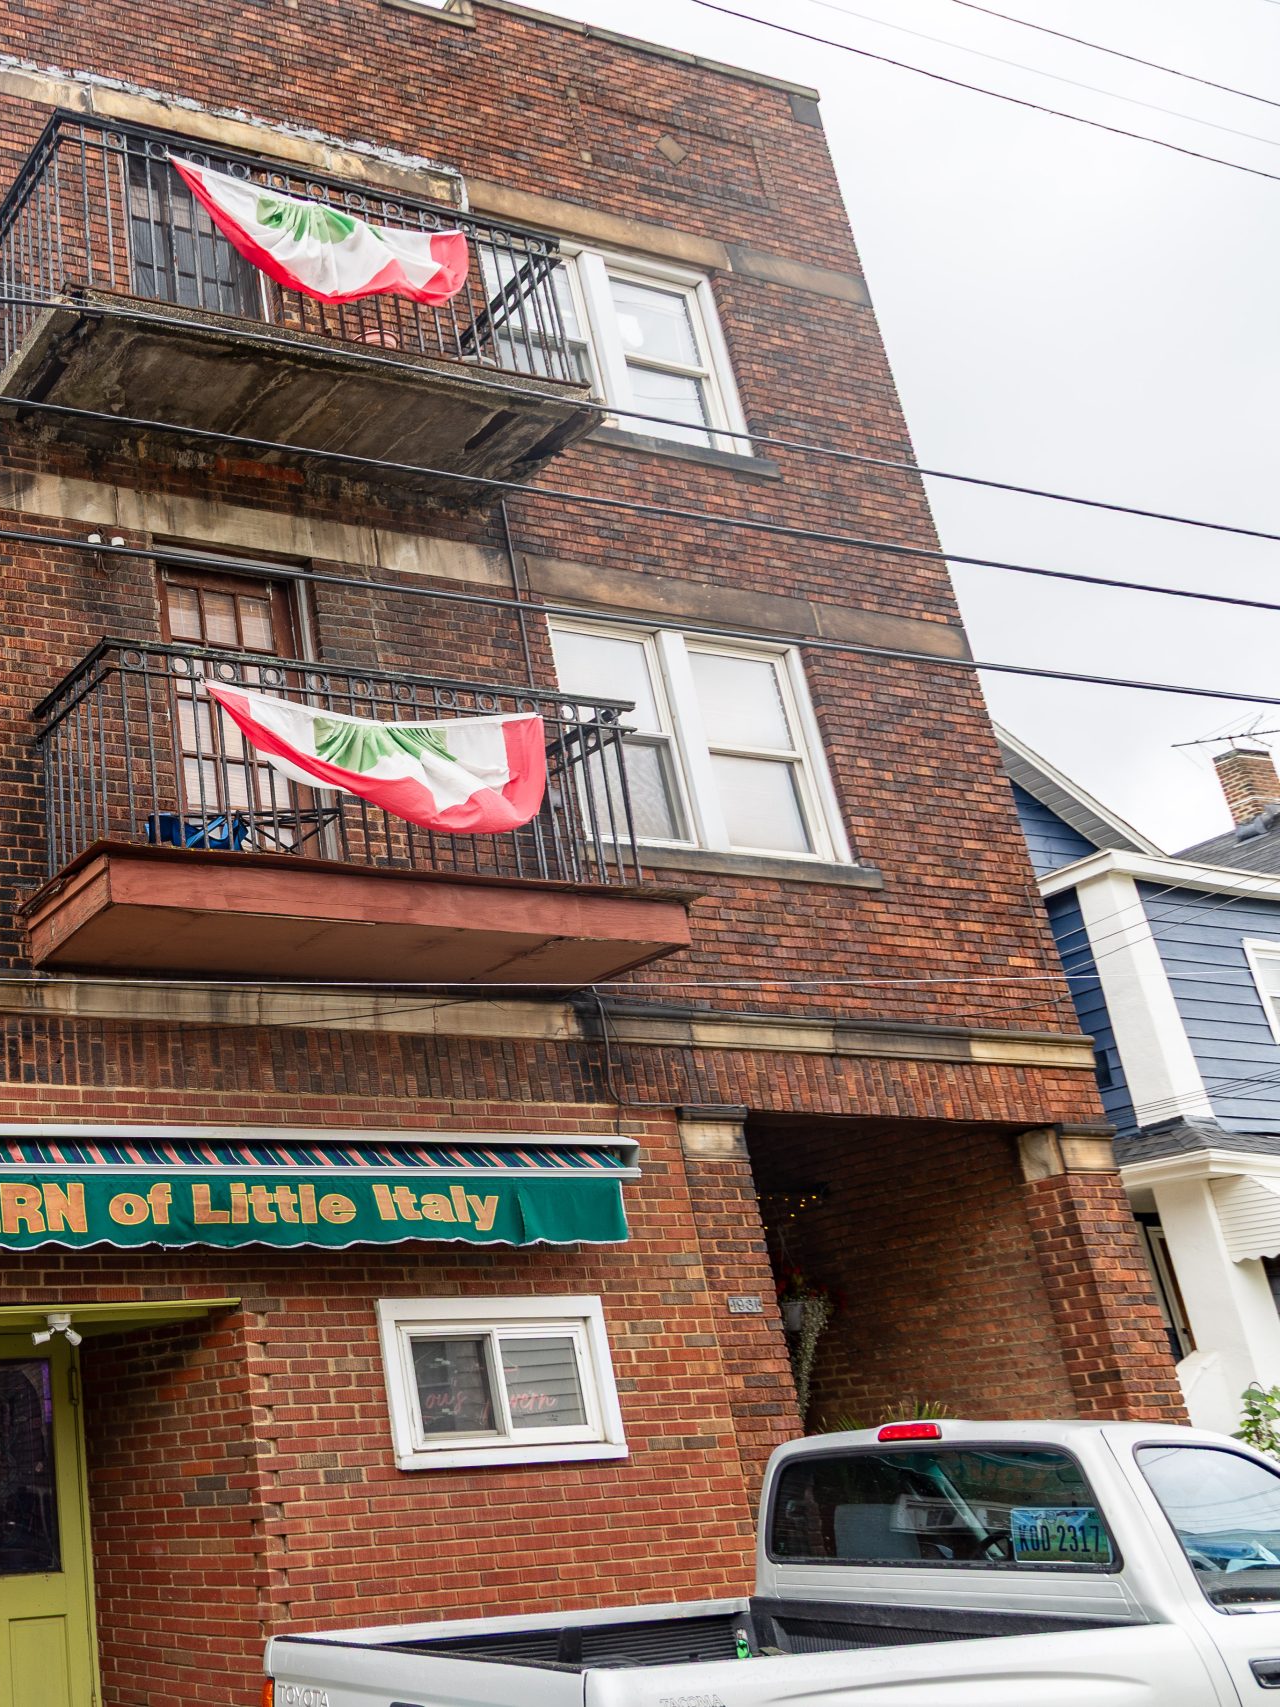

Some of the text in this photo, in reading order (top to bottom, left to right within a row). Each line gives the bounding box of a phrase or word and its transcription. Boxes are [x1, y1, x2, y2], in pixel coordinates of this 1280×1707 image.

[108, 1182, 173, 1226] of
[191, 1182, 357, 1226] Little
[372, 1183, 500, 1232] Italy
[1056, 1524, 1100, 1553] 2317
[277, 1684, 330, 1707] TOYOTA
